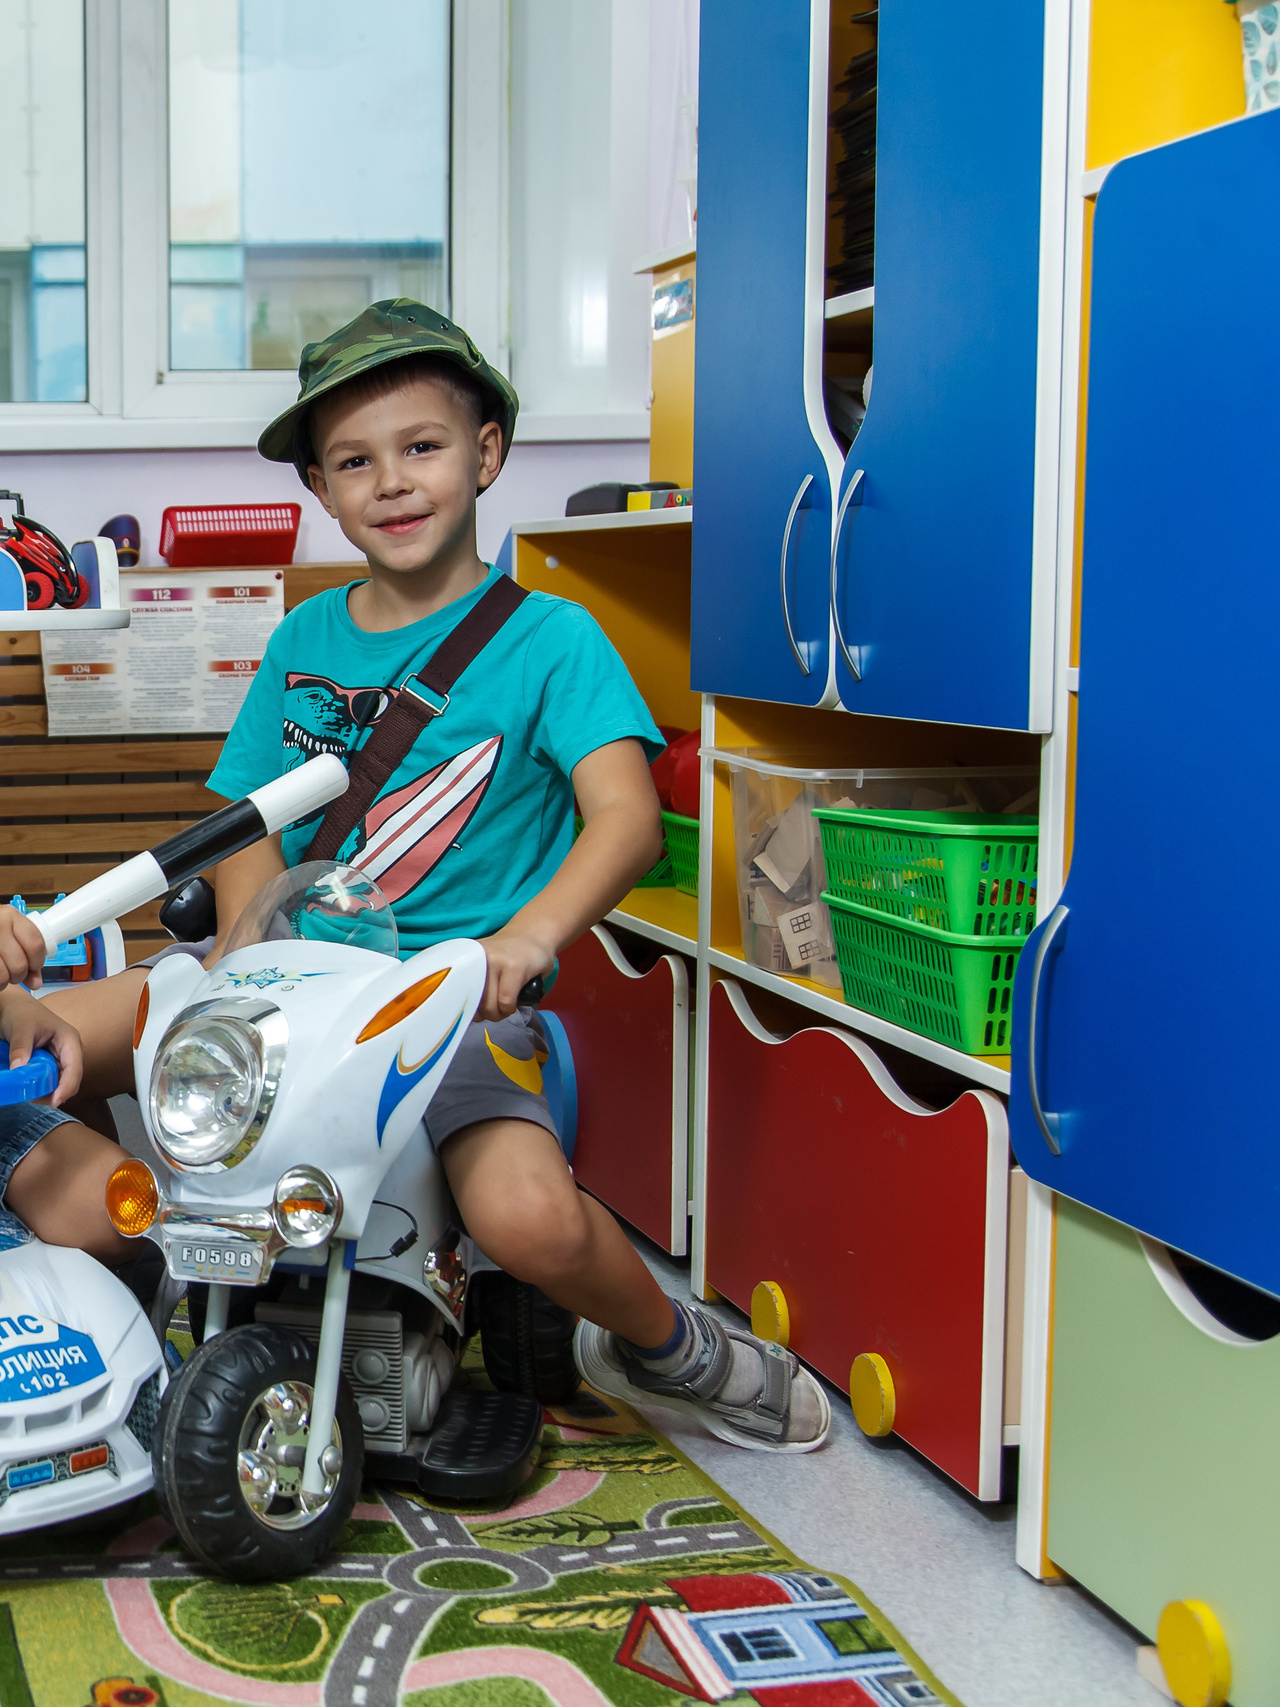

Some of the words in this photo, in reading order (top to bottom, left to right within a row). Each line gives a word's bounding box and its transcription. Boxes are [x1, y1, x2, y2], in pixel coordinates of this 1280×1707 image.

[152, 589, 171, 600] 112
[233, 587, 250, 597] 101
[72, 665, 91, 674] 104
[233, 662, 252, 670] 103
[30, 1372, 69, 1391] 102
